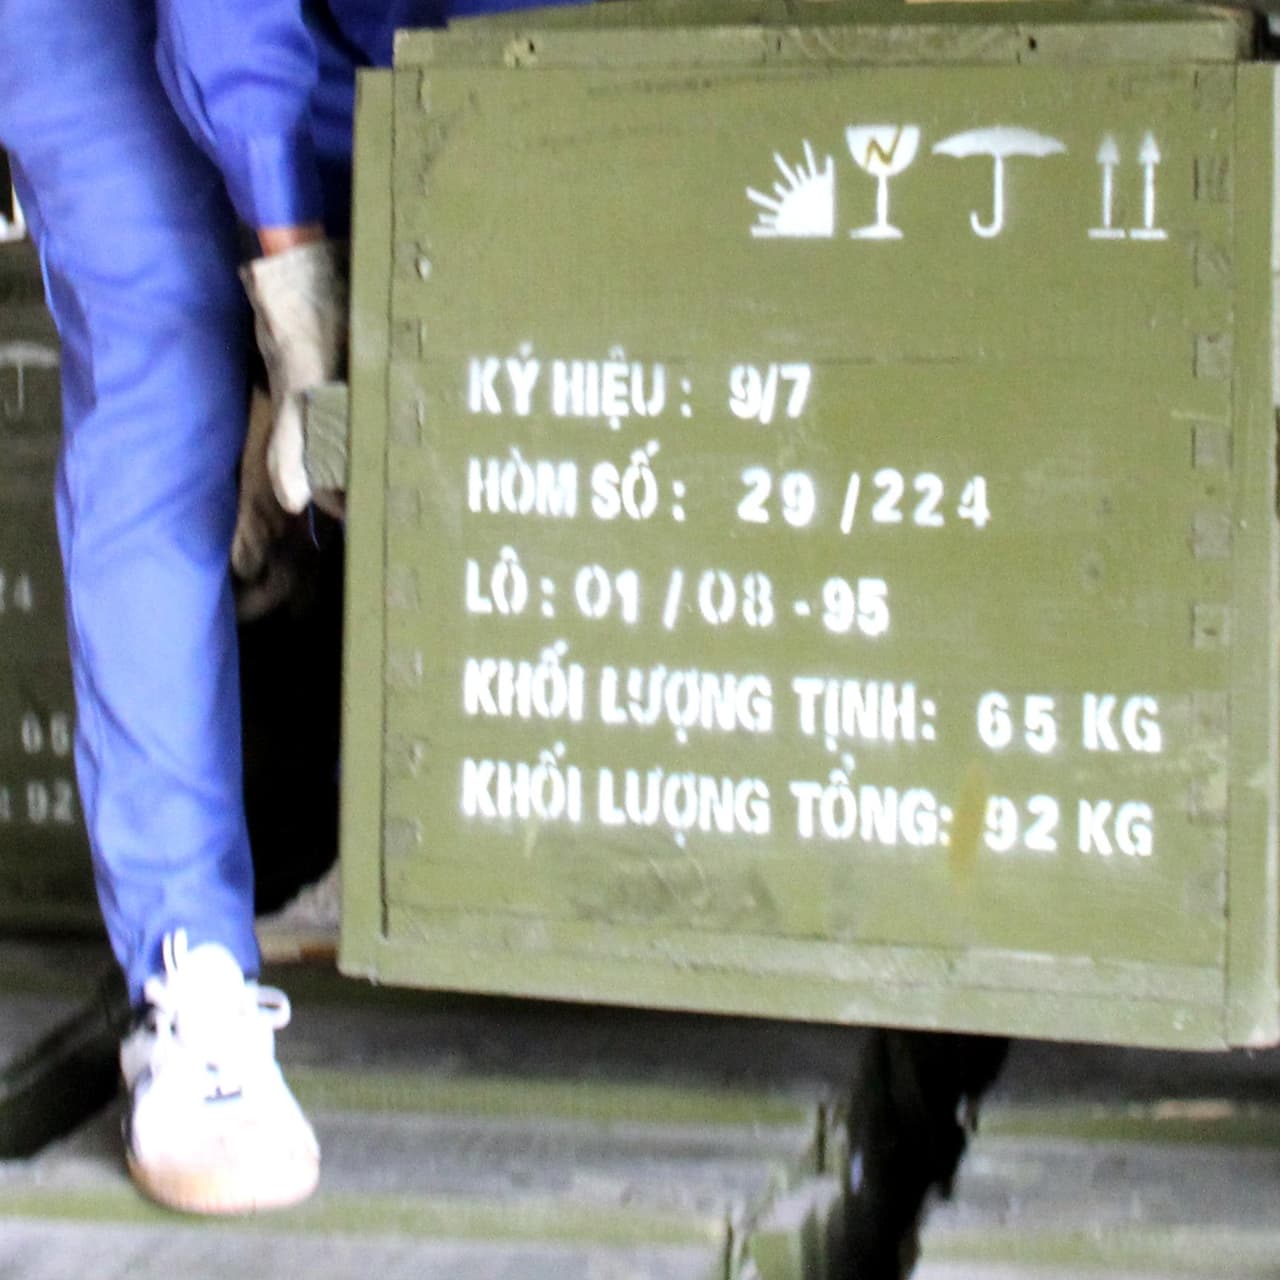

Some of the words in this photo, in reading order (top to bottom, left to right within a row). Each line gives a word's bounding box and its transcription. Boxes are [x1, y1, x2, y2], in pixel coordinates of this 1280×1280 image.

[467, 342, 539, 415] KÝ
[729, 363, 812, 424] 9/7
[467, 447, 577, 518] HÒM
[463, 640, 584, 724] KHỐI
[599, 663, 773, 744] LƯỢNG
[791, 676, 937, 752] TỊNH:
[976, 690, 1056, 753] 65
[1081, 692, 1163, 753] KG
[461, 741, 582, 821] KHỐI
[598, 764, 771, 849] LƯỢNG
[788, 754, 953, 847] TỔNG:
[983, 795, 1059, 852] 92
[1077, 799, 1154, 857] KG
